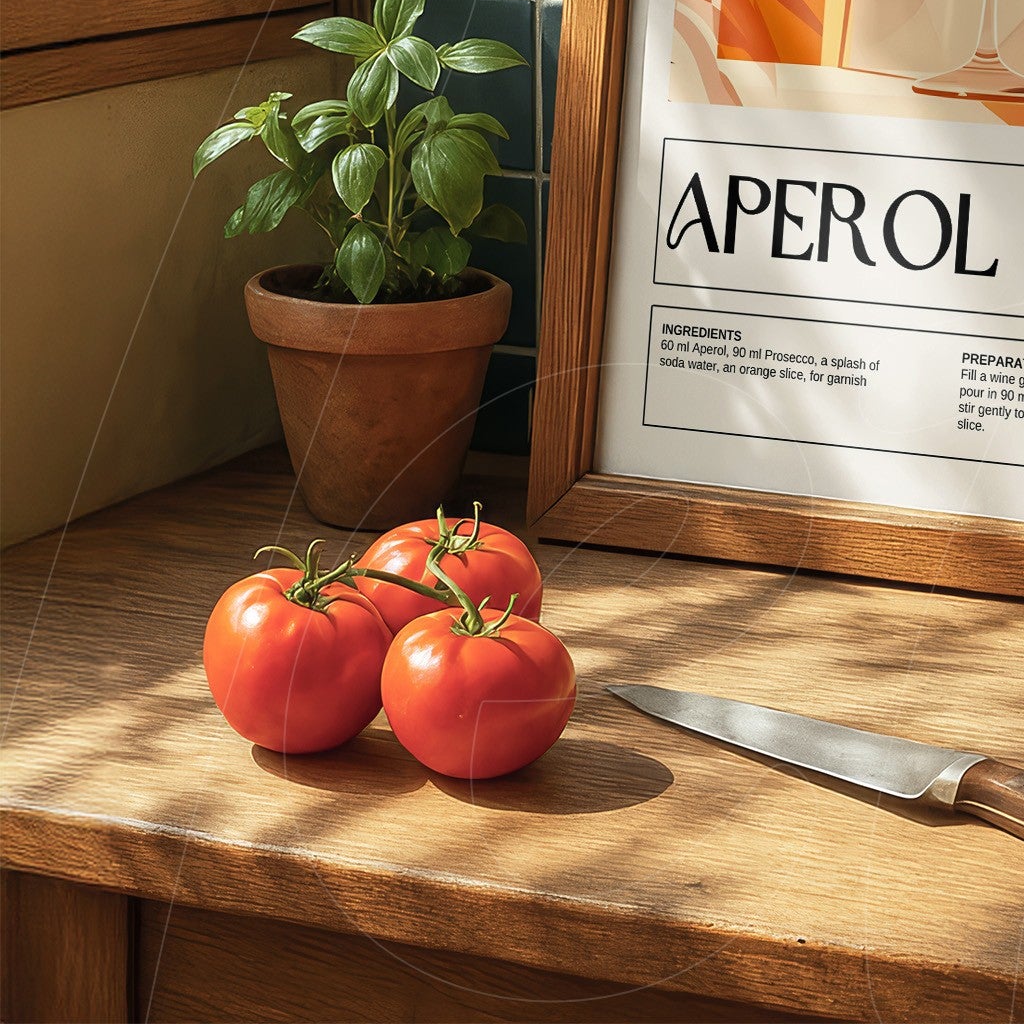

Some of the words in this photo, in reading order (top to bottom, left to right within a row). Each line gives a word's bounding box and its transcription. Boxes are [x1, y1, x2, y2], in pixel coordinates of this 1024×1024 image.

[665, 172, 999, 278] APEROL
[662, 323, 742, 342] INGREDIENTS
[660, 339, 674, 351] 60
[676, 341, 690, 352] ml
[691, 342, 729, 358] Aperol,
[732, 346, 746, 358] 90
[749, 348, 762, 359] ml
[764, 349, 817, 367] Prosecco,
[820, 357, 828, 366] a
[830, 356, 866, 370] splash
[869, 360, 880, 371] of
[659, 356, 685, 368] soda
[687, 360, 720, 373] water,
[722, 364, 736, 373] an
[739, 365, 777, 380] orange
[779, 367, 806, 382] slice,
[809, 369, 825, 382] for
[827, 374, 867, 387] garnish
[961, 368, 977, 381] Fill
[979, 372, 987, 382] a
[989, 371, 1016, 385] wine
[959, 387, 985, 399] pour
[987, 387, 997, 399] in
[1000, 389, 1015, 401] 90
[958, 402, 976, 414] stir
[978, 405, 1012, 420] gently
[1014, 408, 1024, 419] to
[957, 418, 984, 432] slice.
